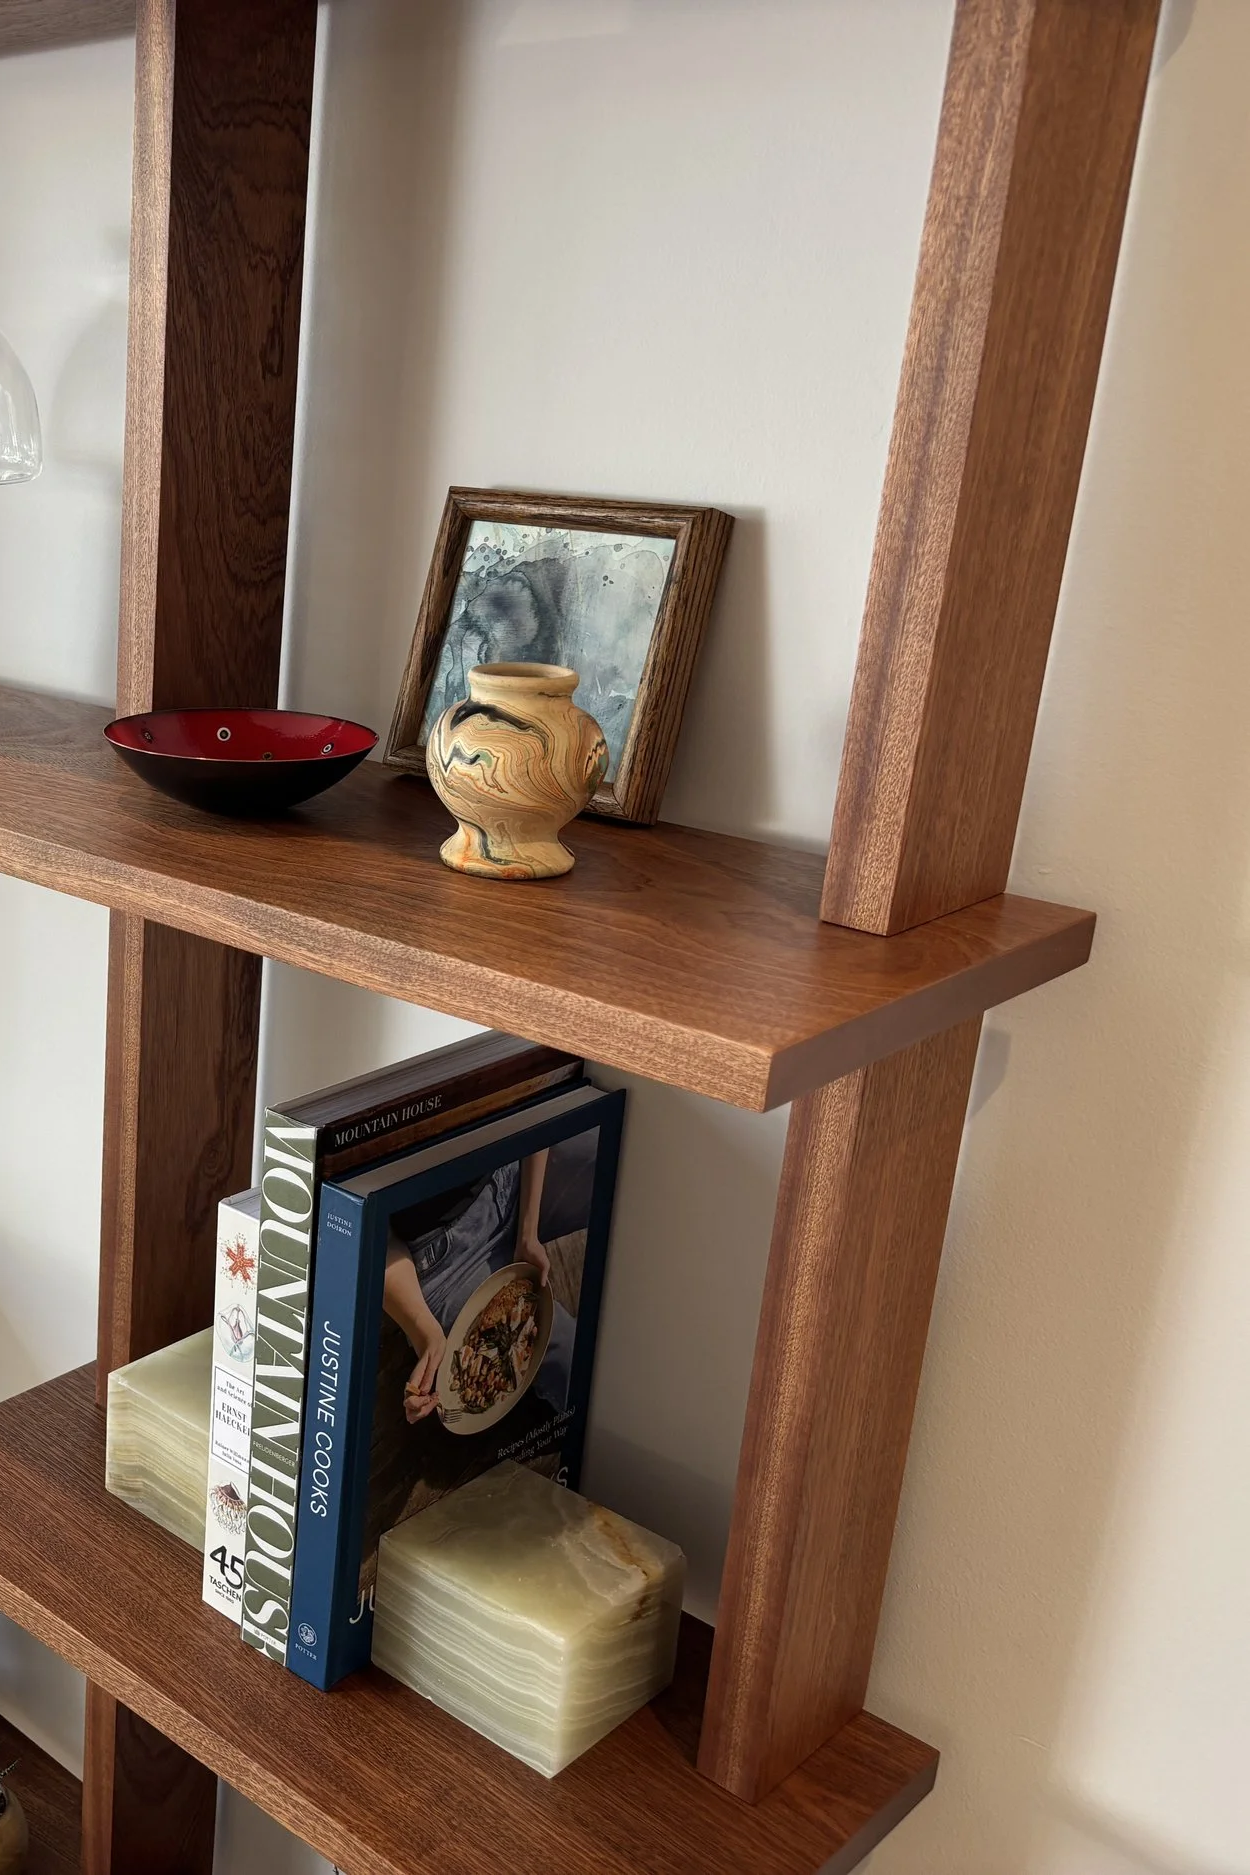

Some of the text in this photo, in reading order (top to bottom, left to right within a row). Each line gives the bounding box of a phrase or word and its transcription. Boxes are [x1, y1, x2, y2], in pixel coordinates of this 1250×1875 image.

[334, 1094, 442, 1147] MOUNTAIN HOUSE
[326, 1212, 352, 1228] JUSTINE
[326, 1221, 352, 1237] DOIRON
[253, 1127, 315, 1461] MOUNTAIN
[217, 1385, 228, 1395] and
[226, 1381, 245, 1396] The Art
[221, 1402, 246, 1423] ERNST
[310, 1320, 341, 1518] JUSTINE COOKS
[252, 1439, 296, 1468] FREUDENBERGER
[497, 1440, 525, 1459] Recipes
[209, 1545, 244, 1590] 45
[209, 1574, 242, 1602] TASCHEN
[294, 1642, 318, 1661] POTTER
